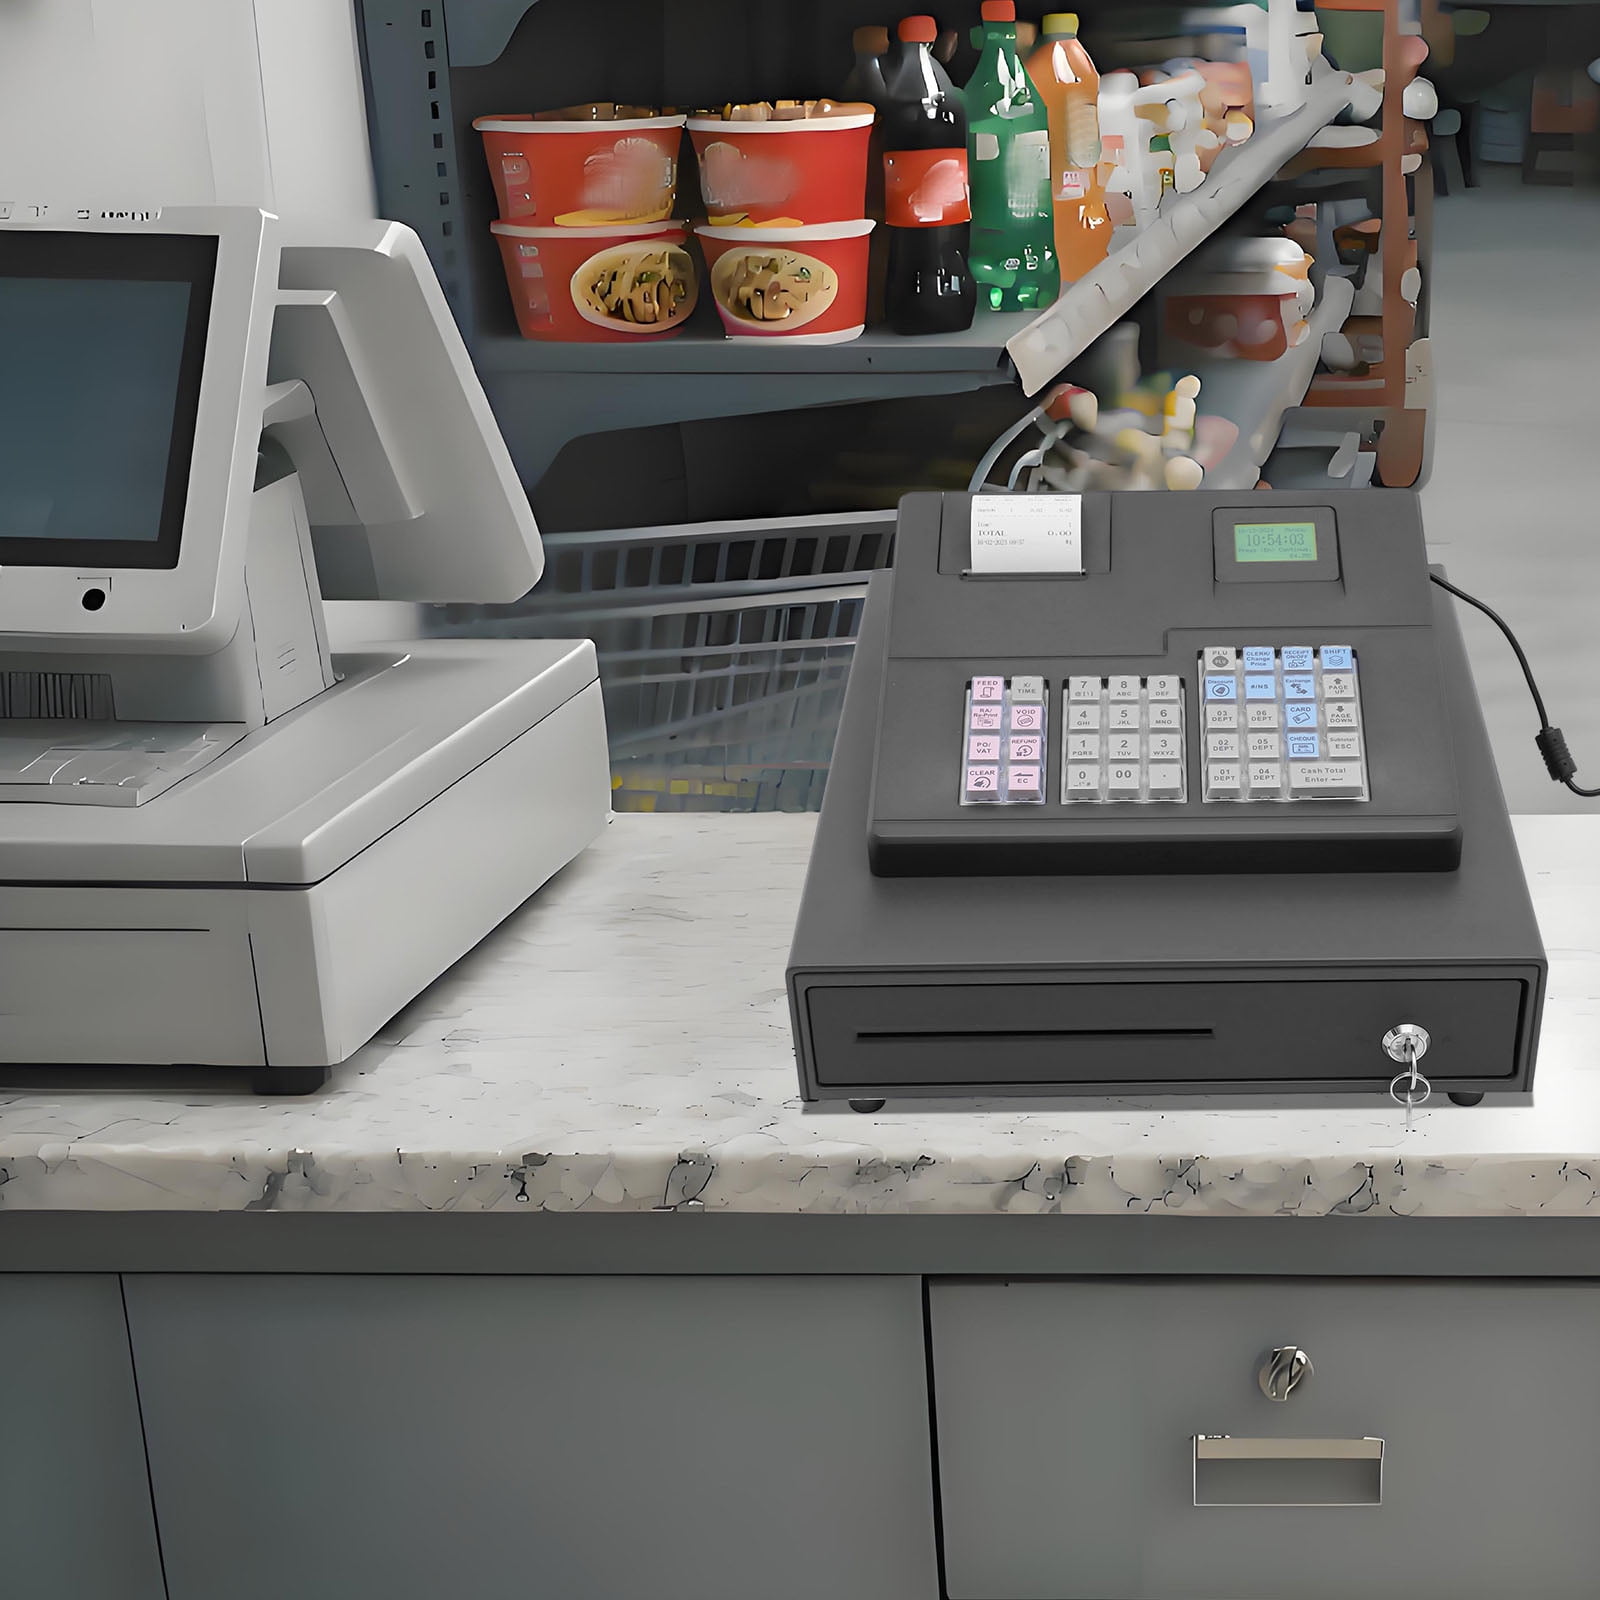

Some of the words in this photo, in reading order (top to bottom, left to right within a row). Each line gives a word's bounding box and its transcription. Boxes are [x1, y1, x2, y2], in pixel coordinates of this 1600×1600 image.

[1247, 533, 1305, 546] 10:54:03
[1159, 680, 1166, 688] 9
[1080, 710, 1087, 719] 4
[1120, 710, 1127, 718] 5
[1160, 709, 1167, 718] 6
[1080, 740, 1086, 748] 1
[1120, 740, 1128, 748] 2
[1160, 740, 1167, 748] 3
[1079, 771, 1086, 779] 0
[1116, 770, 1132, 778] 00
